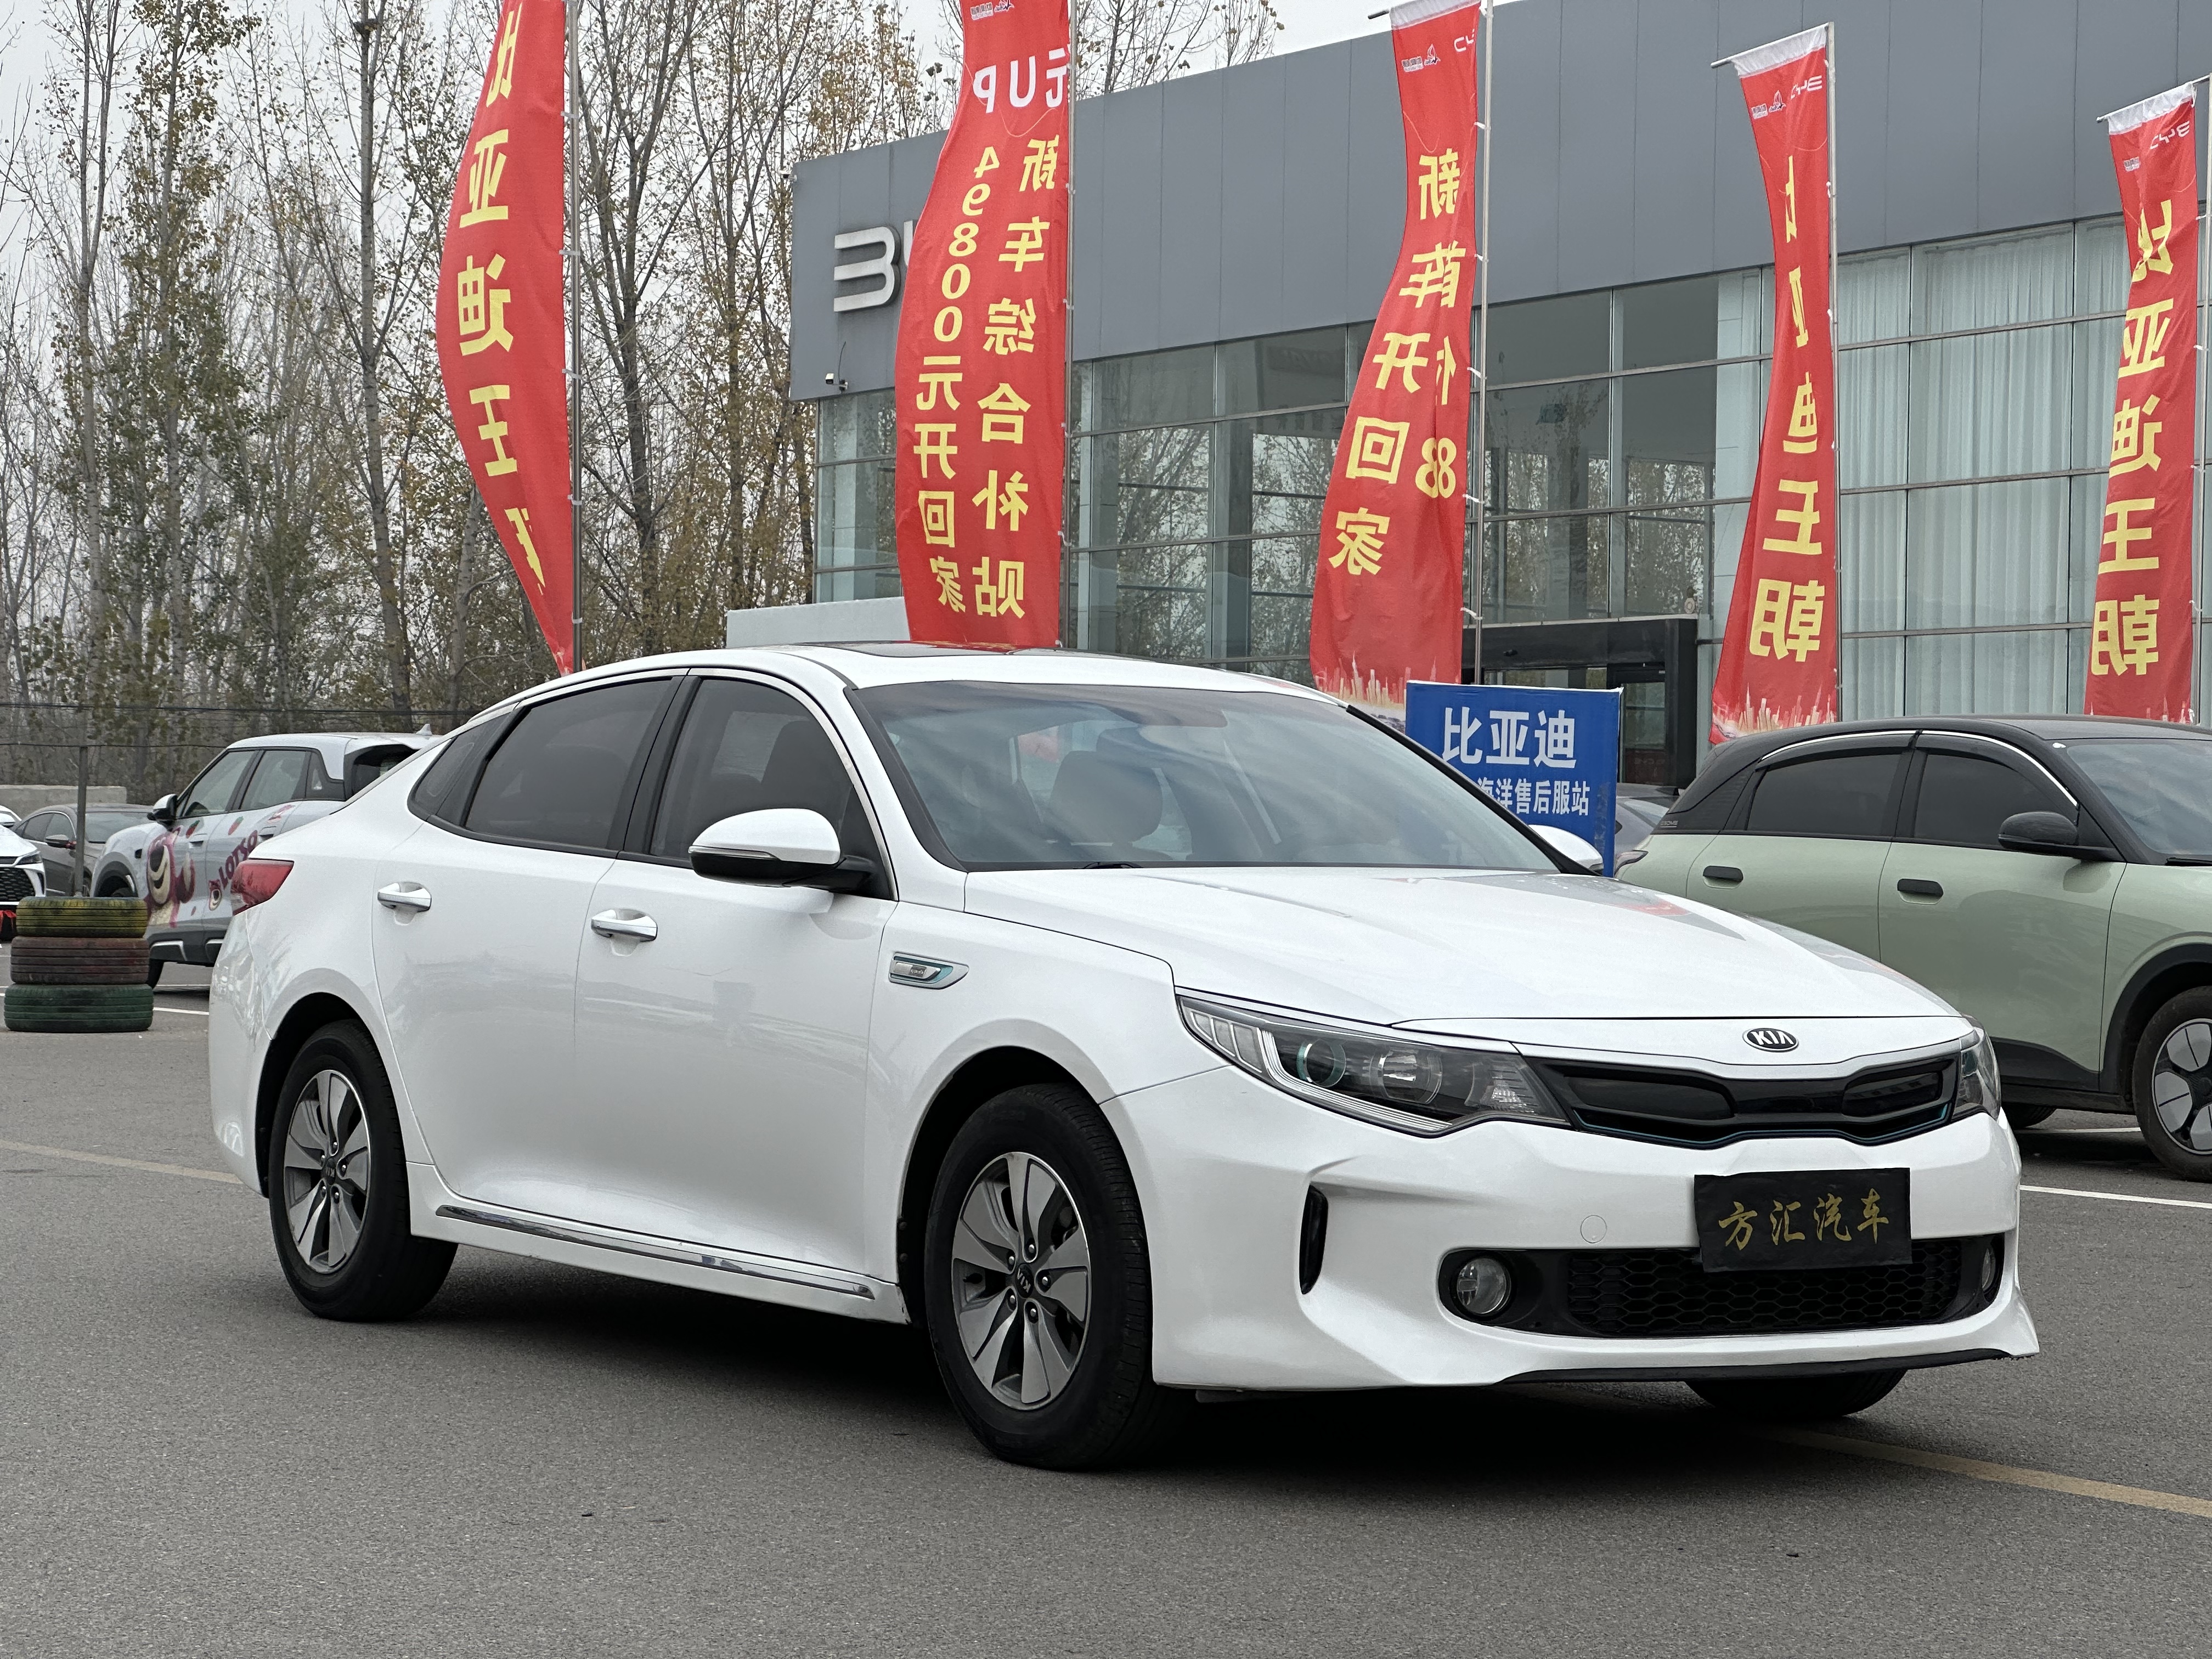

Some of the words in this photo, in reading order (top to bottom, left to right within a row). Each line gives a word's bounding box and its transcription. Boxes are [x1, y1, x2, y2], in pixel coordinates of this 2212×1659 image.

[1442, 706, 1577, 769] 比亚迪
[1751, 1030, 1795, 1046] KIA
[1718, 1188, 1889, 1251] 方汇汽车
